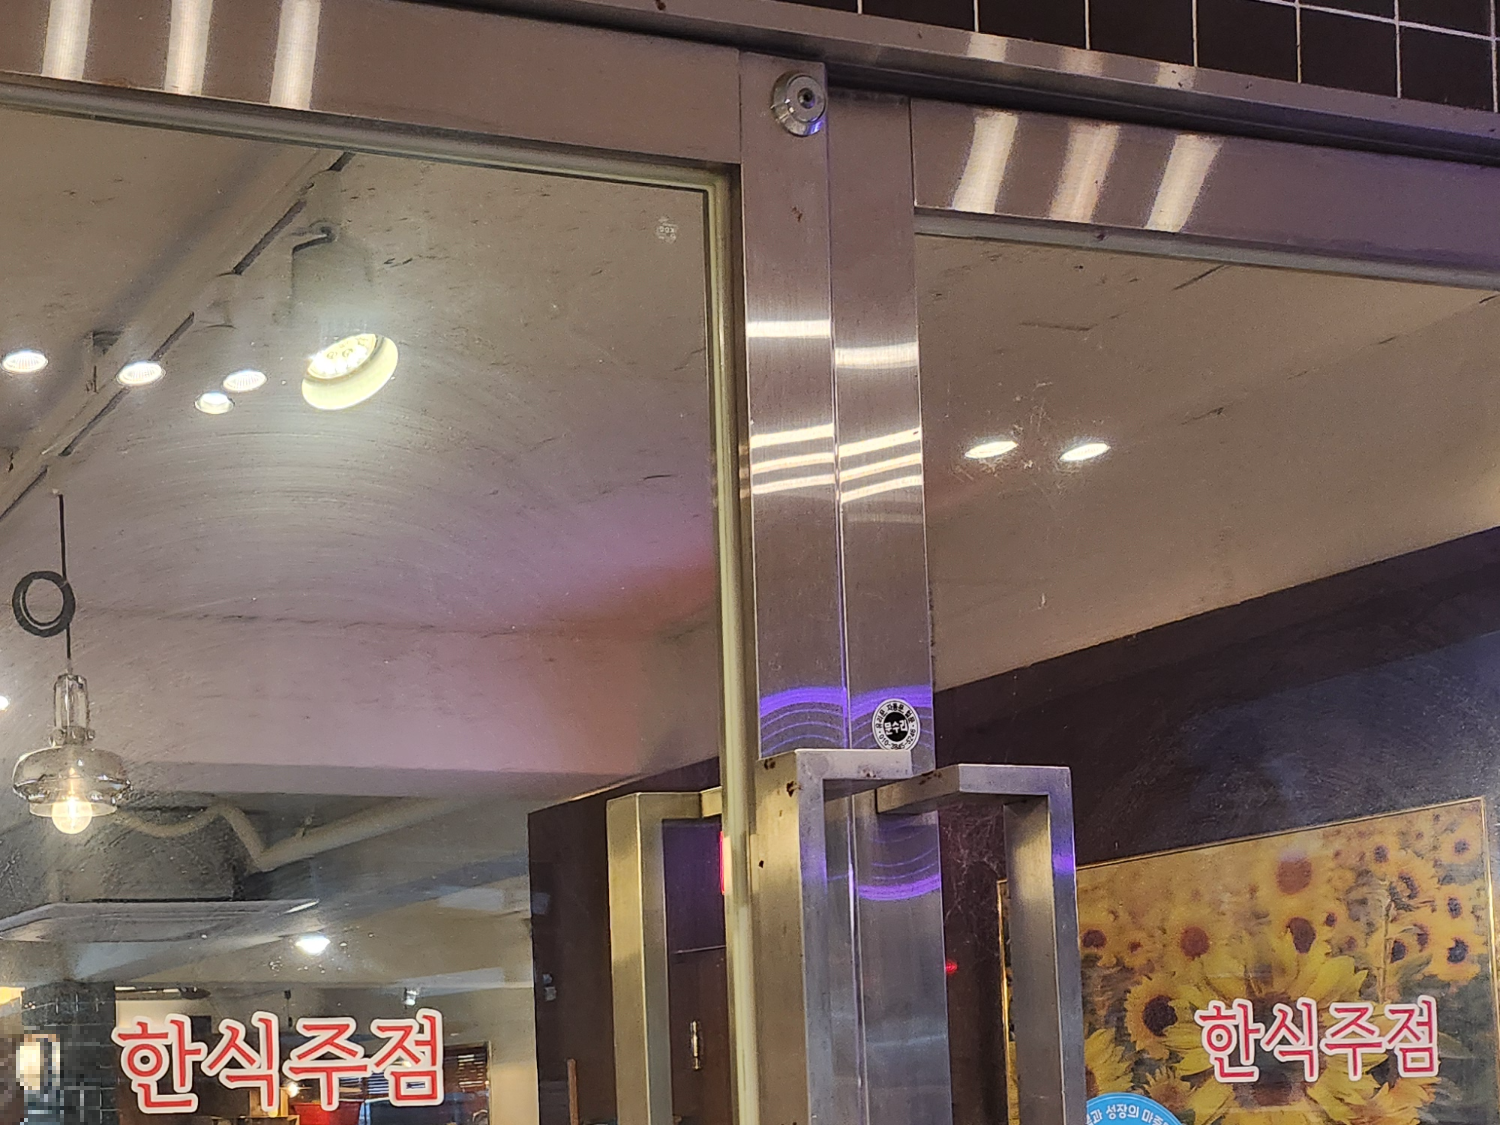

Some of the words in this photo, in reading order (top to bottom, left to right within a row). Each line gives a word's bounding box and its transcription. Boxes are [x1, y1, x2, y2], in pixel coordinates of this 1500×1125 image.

[884, 720, 908, 735] 문수리
[112, 1008, 444, 1114] 한식주점
[1194, 995, 1438, 1082] 한식주점
[1106, 1103, 1139, 1120] 성장의
